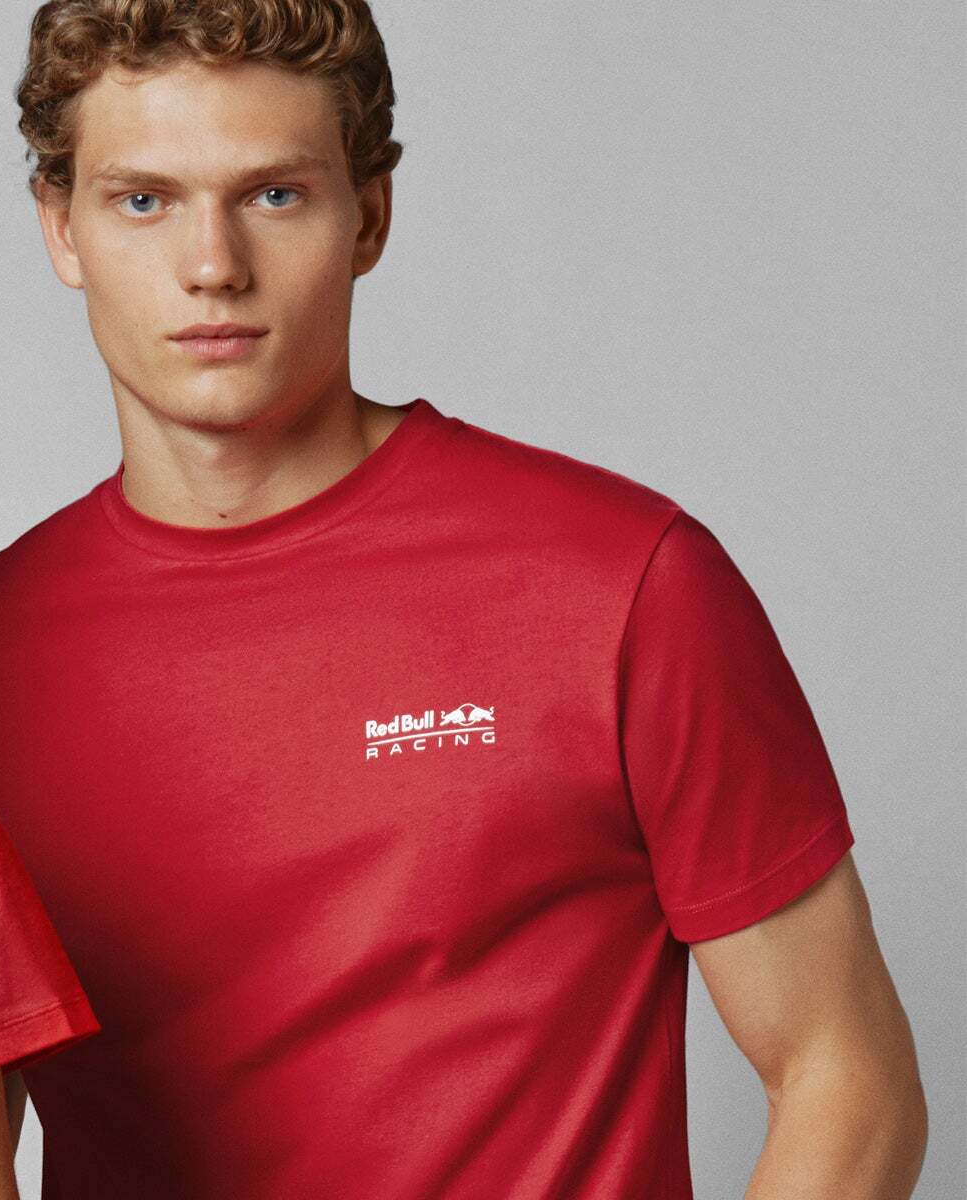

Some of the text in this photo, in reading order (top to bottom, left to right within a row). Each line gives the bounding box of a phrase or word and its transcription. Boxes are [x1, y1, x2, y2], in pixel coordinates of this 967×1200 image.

[365, 710, 435, 739] Red Bull
[365, 731, 496, 760] RACING
